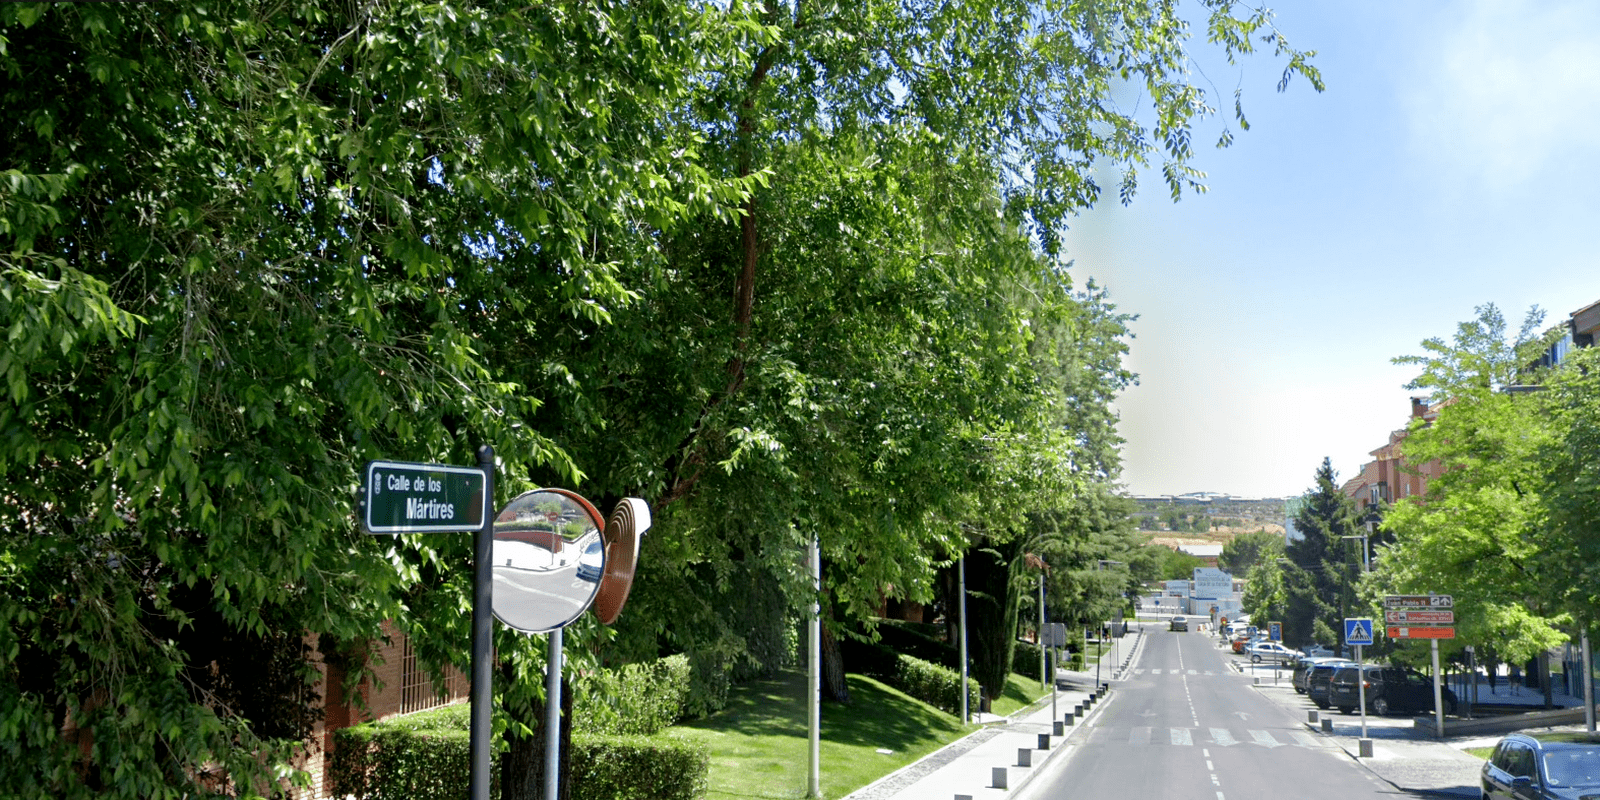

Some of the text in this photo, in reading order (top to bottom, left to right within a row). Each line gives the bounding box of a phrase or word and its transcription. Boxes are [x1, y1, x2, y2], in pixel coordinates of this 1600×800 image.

[388, 474, 441, 492] Calle de los
[406, 497, 454, 519] Mártires
